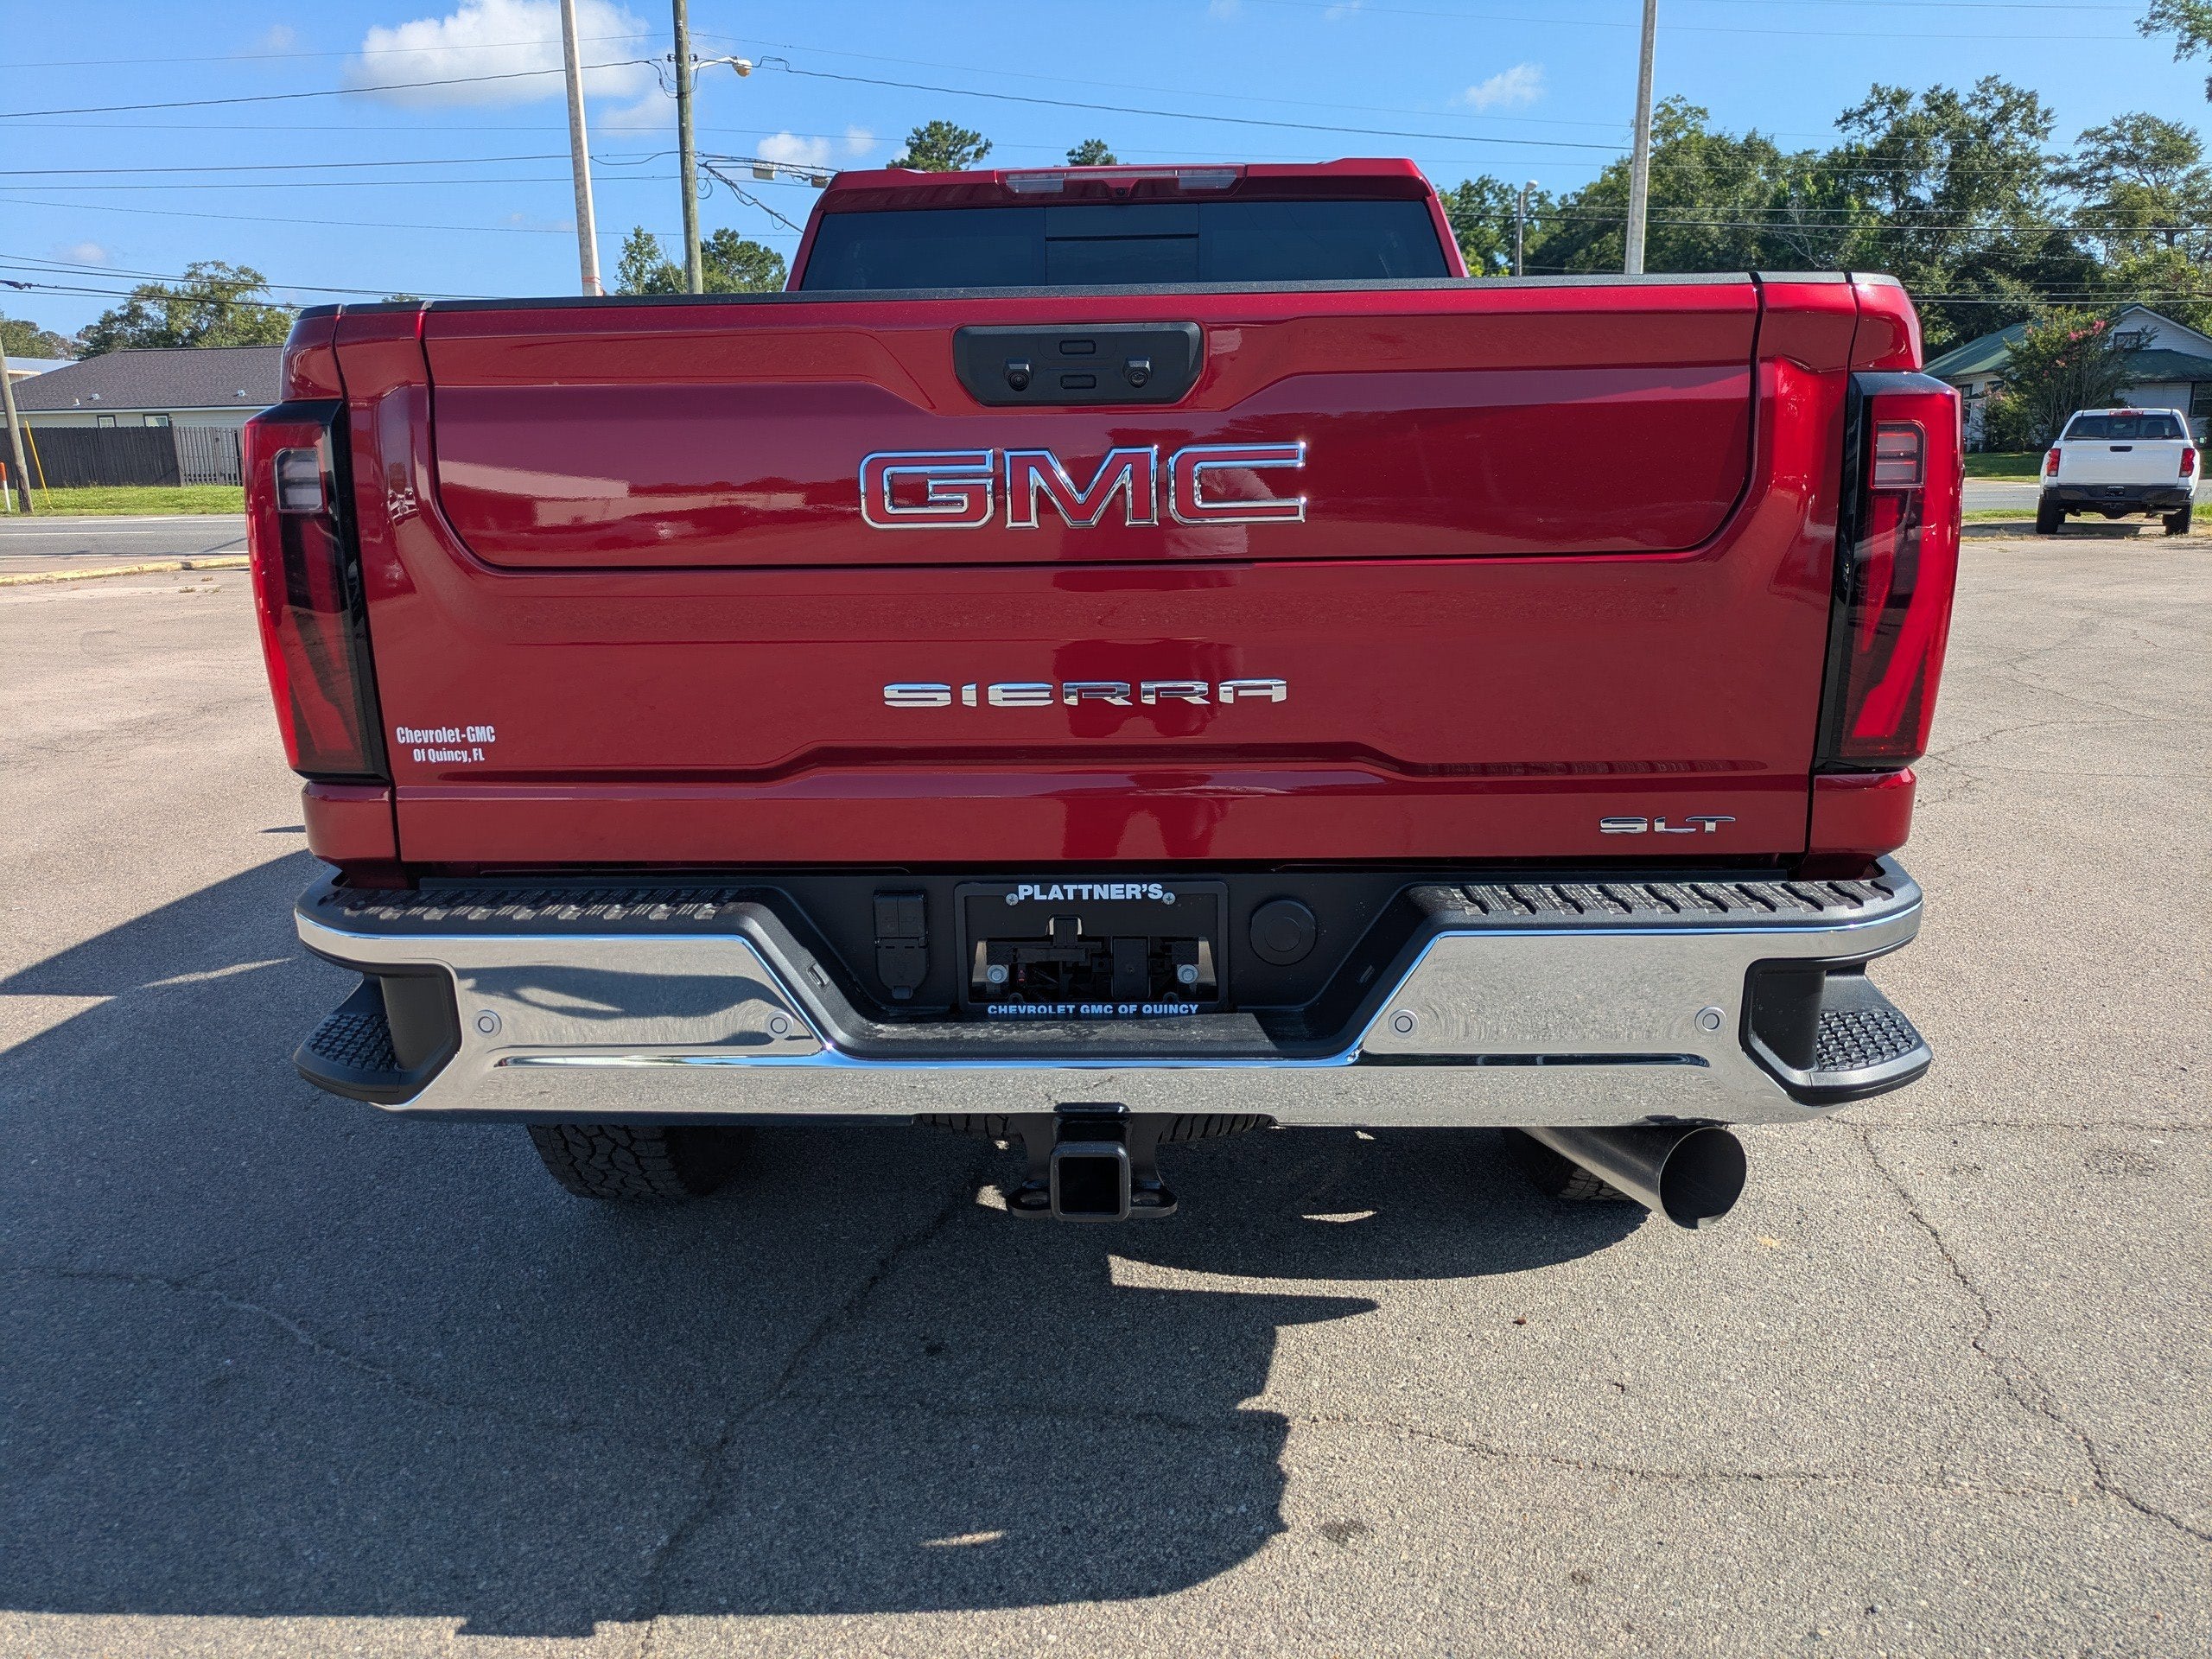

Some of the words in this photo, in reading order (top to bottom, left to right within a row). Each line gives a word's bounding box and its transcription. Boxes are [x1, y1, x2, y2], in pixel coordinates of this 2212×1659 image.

[860, 442, 1306, 530] GMC
[883, 679, 1287, 708] SIERRA
[396, 725, 496, 744] Chevrolet-GMC
[413, 748, 426, 762] Of
[427, 747, 472, 763] Quincy,
[473, 747, 485, 761] FL
[1599, 816, 1736, 834] SLT
[1018, 883, 1163, 900] PLATTNER'S
[988, 1004, 1075, 1014] CHEVROLET
[1080, 1004, 1114, 1014] GMC
[1118, 1004, 1137, 1014] OF
[1142, 1003, 1199, 1014] QUINCY
